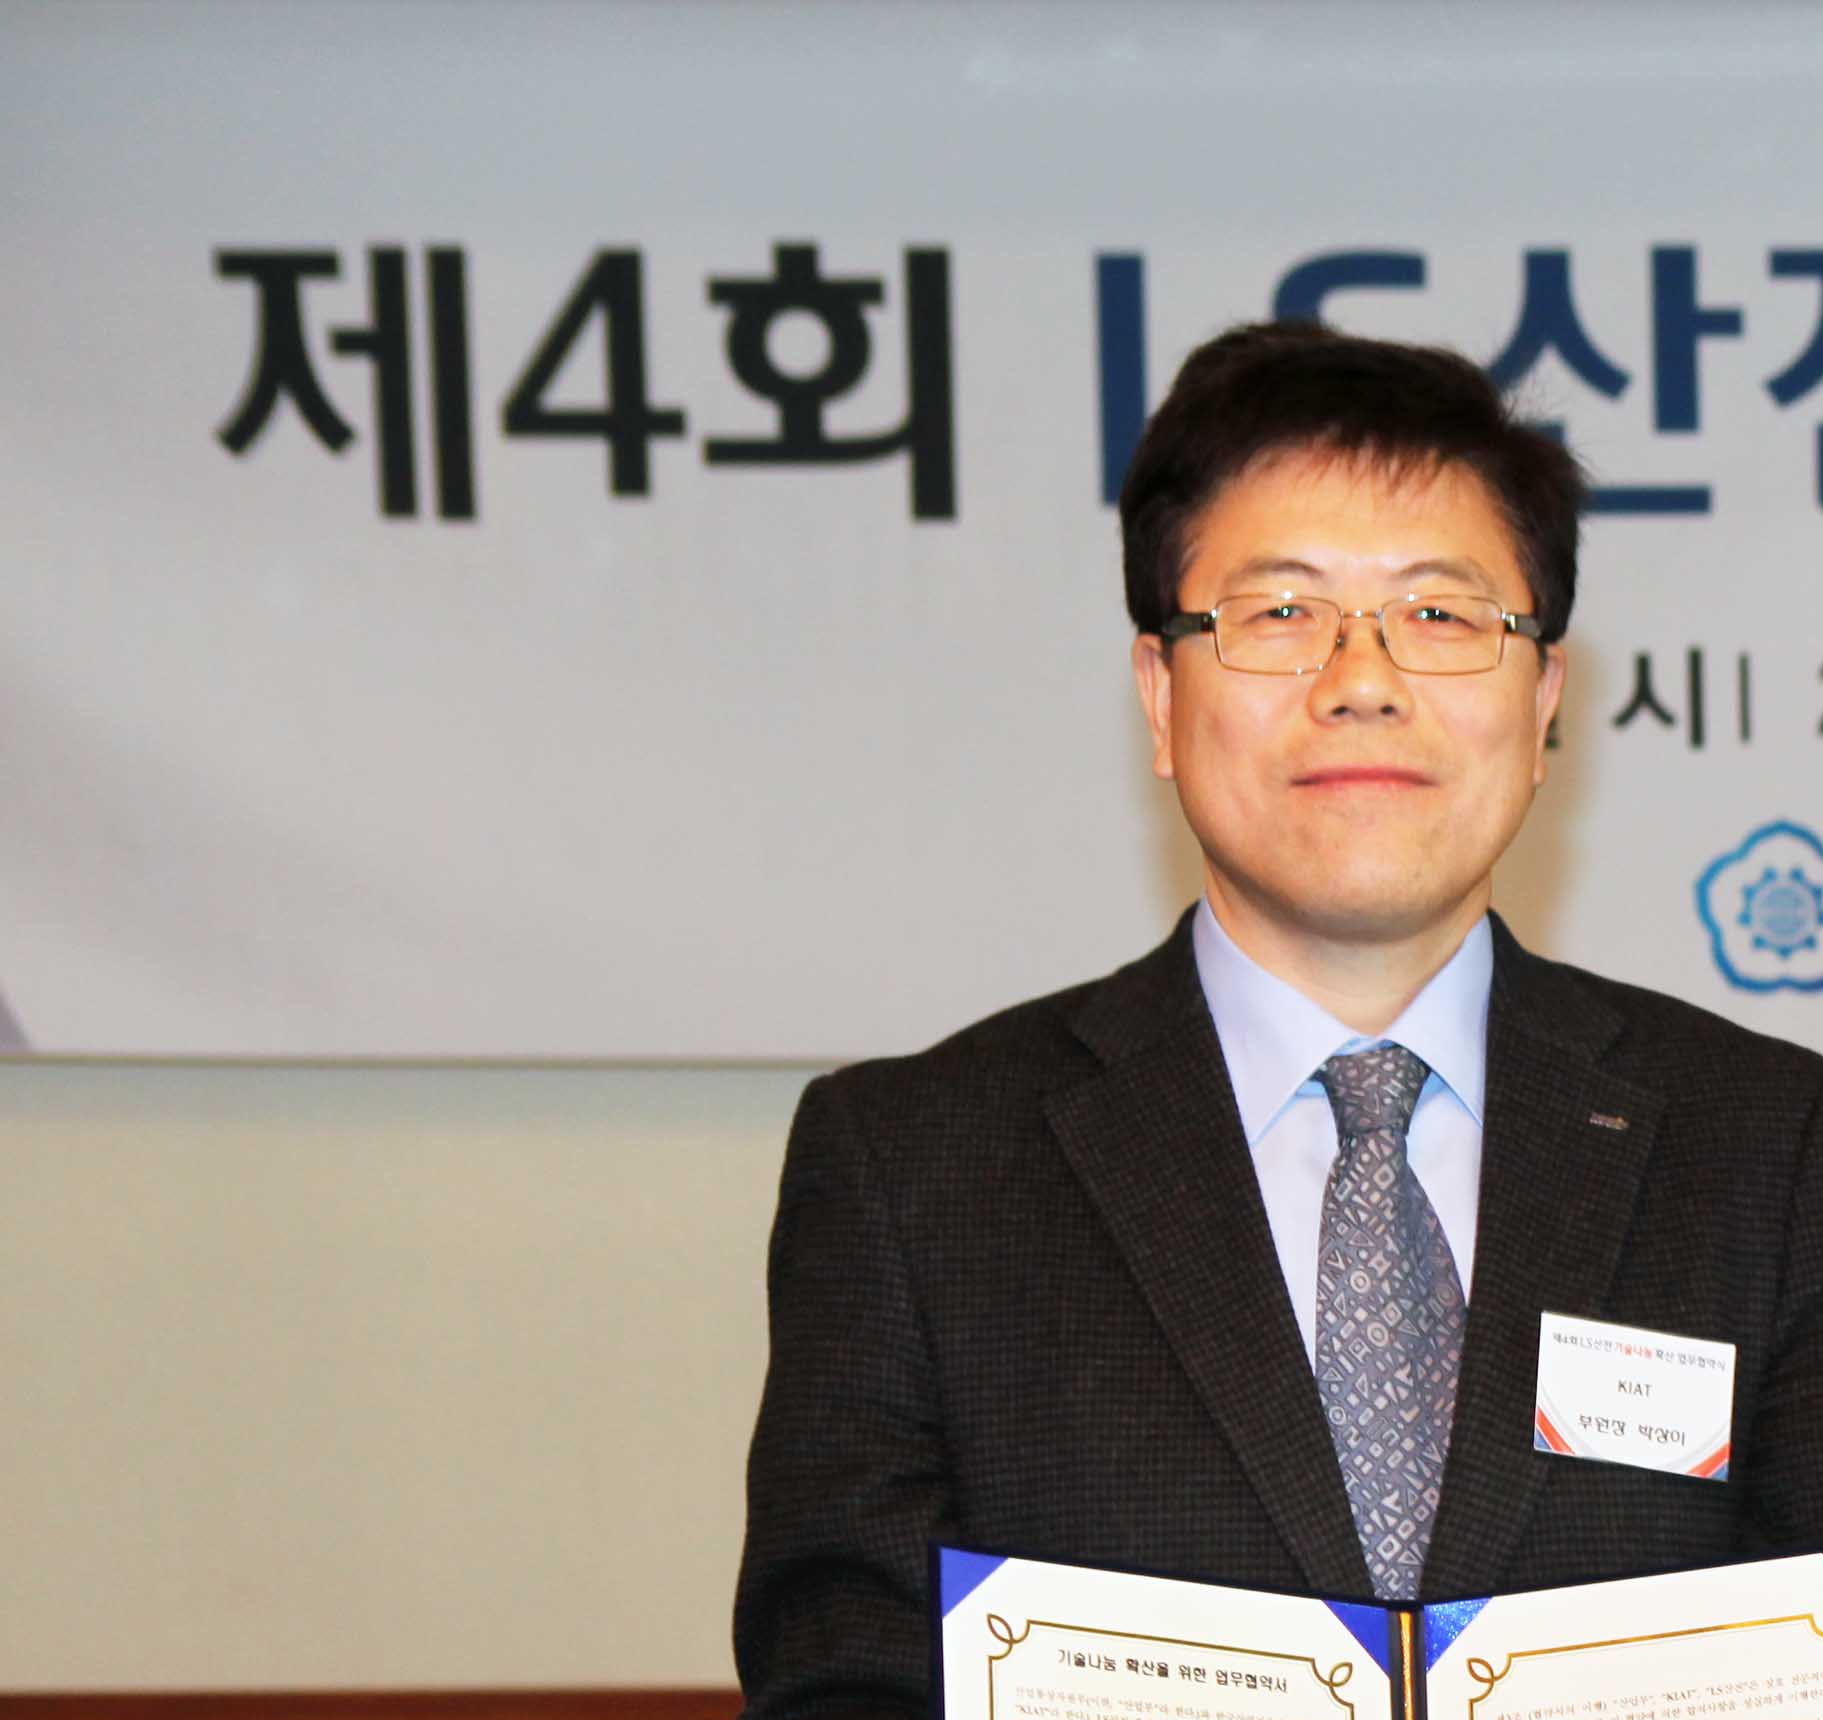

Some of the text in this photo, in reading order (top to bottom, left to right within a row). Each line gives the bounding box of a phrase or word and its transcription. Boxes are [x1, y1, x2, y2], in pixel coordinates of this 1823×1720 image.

[212, 240, 960, 522] 제4회
[1617, 1379, 1653, 1398] KIAT
[1058, 1649, 1289, 1694] 기술나눔 확산을 위한 업무협약서
